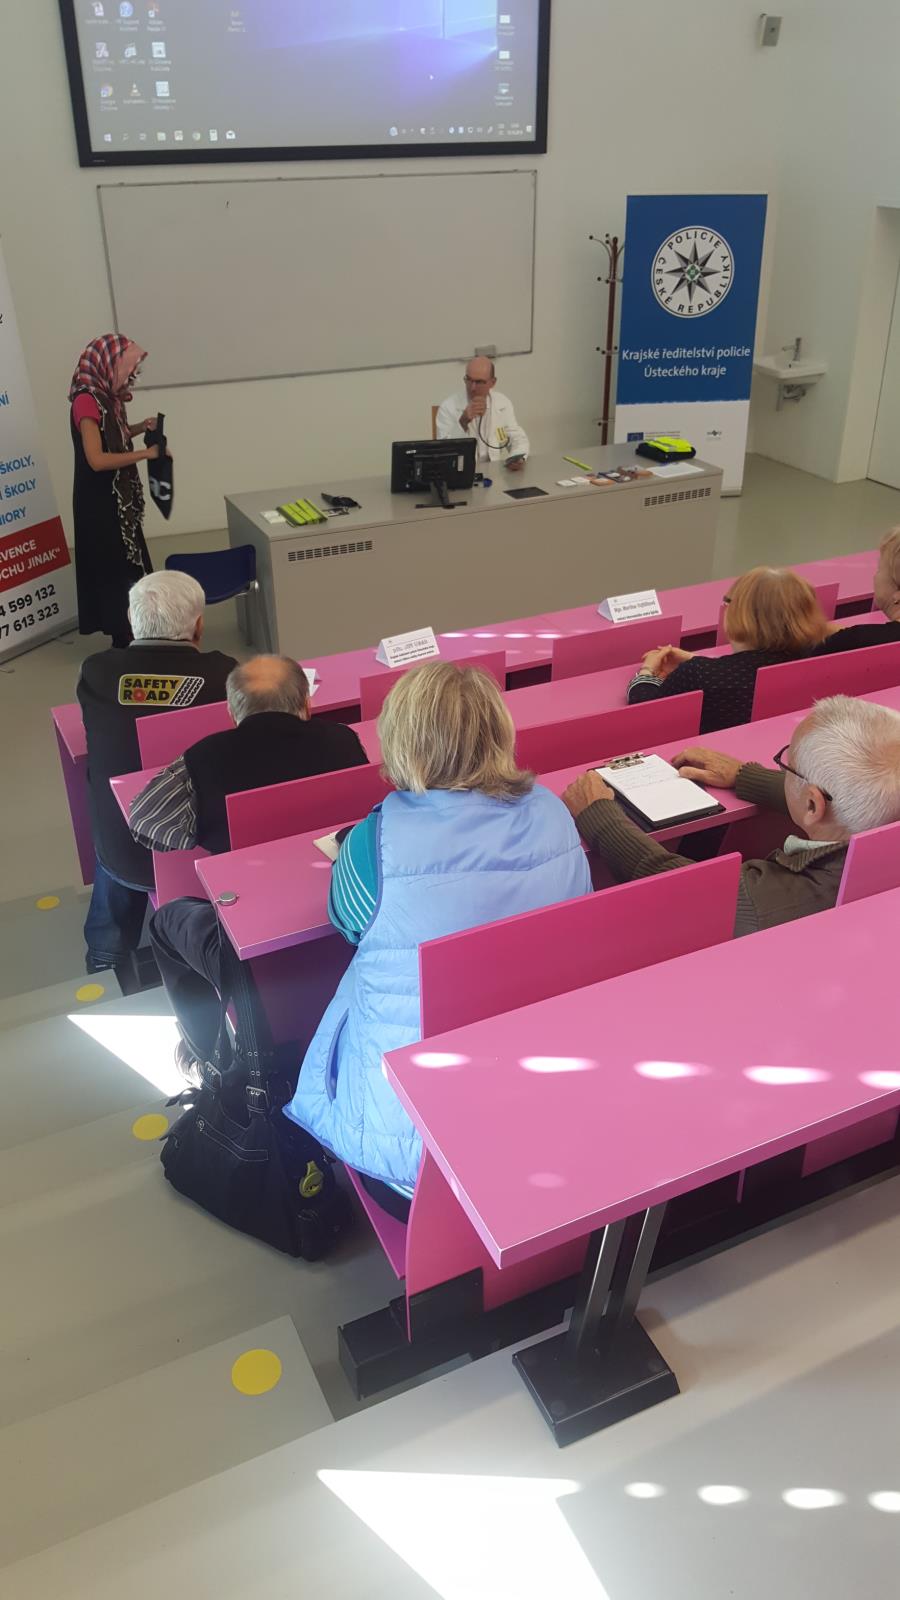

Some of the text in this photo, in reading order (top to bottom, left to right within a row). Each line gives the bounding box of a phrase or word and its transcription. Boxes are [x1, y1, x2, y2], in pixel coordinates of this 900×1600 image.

[667, 230, 722, 250] POLICIE
[677, 255, 730, 313] REPUBLIKY
[622, 346, 751, 363] Krajské ředitelství policie
[644, 365, 727, 379] Ústeckého kraje
[5, 478, 37, 498] ŠKOLY
[0, 562, 25, 582] CHU
[8, 594, 33, 613] 599
[35, 584, 56, 601] 132
[13, 613, 35, 632] 613
[37, 602, 60, 622] 323
[124, 678, 179, 689] SAFETY
[123, 688, 170, 702] ROAD
